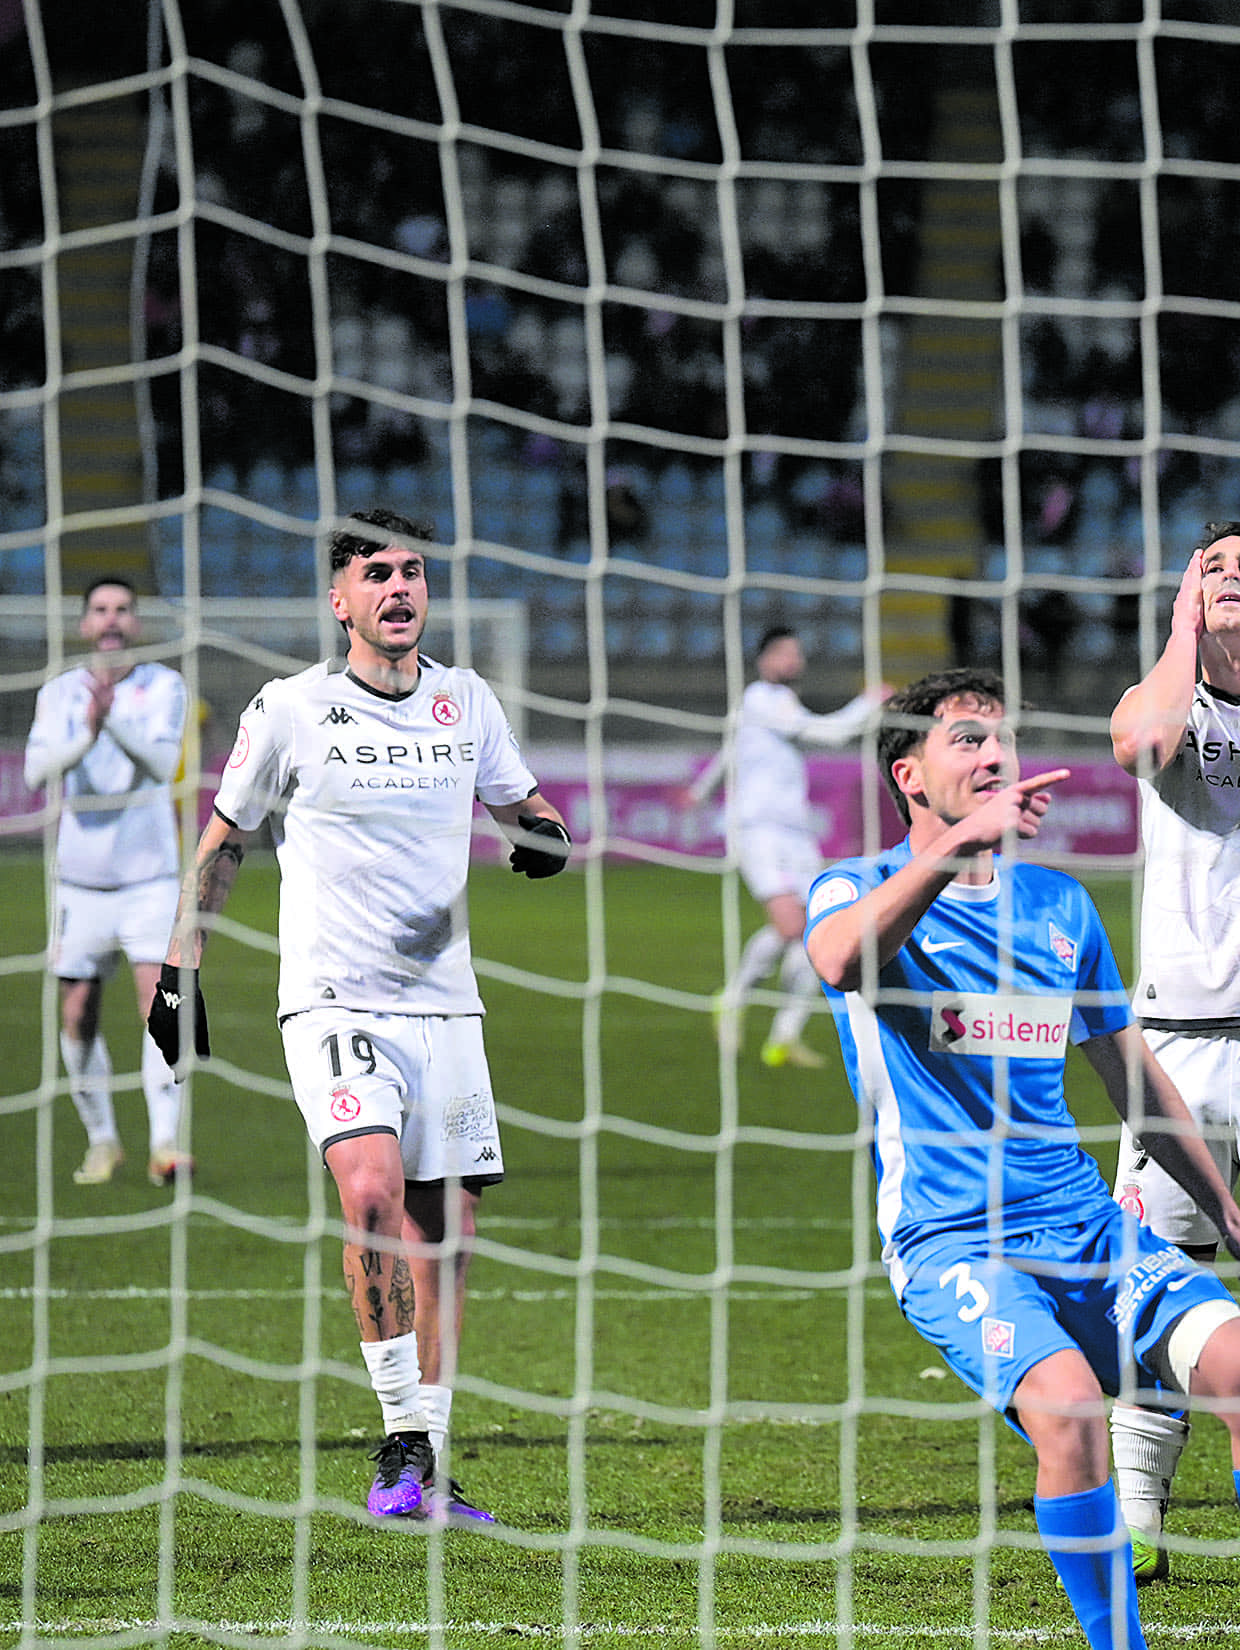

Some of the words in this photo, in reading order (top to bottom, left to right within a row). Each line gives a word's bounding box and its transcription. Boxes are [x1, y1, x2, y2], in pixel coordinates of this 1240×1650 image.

[323, 742, 474, 767] ASPIRE
[350, 777, 460, 789] ACADEMY
[321, 1033, 376, 1077] 19
[939, 1262, 990, 1322] 3
